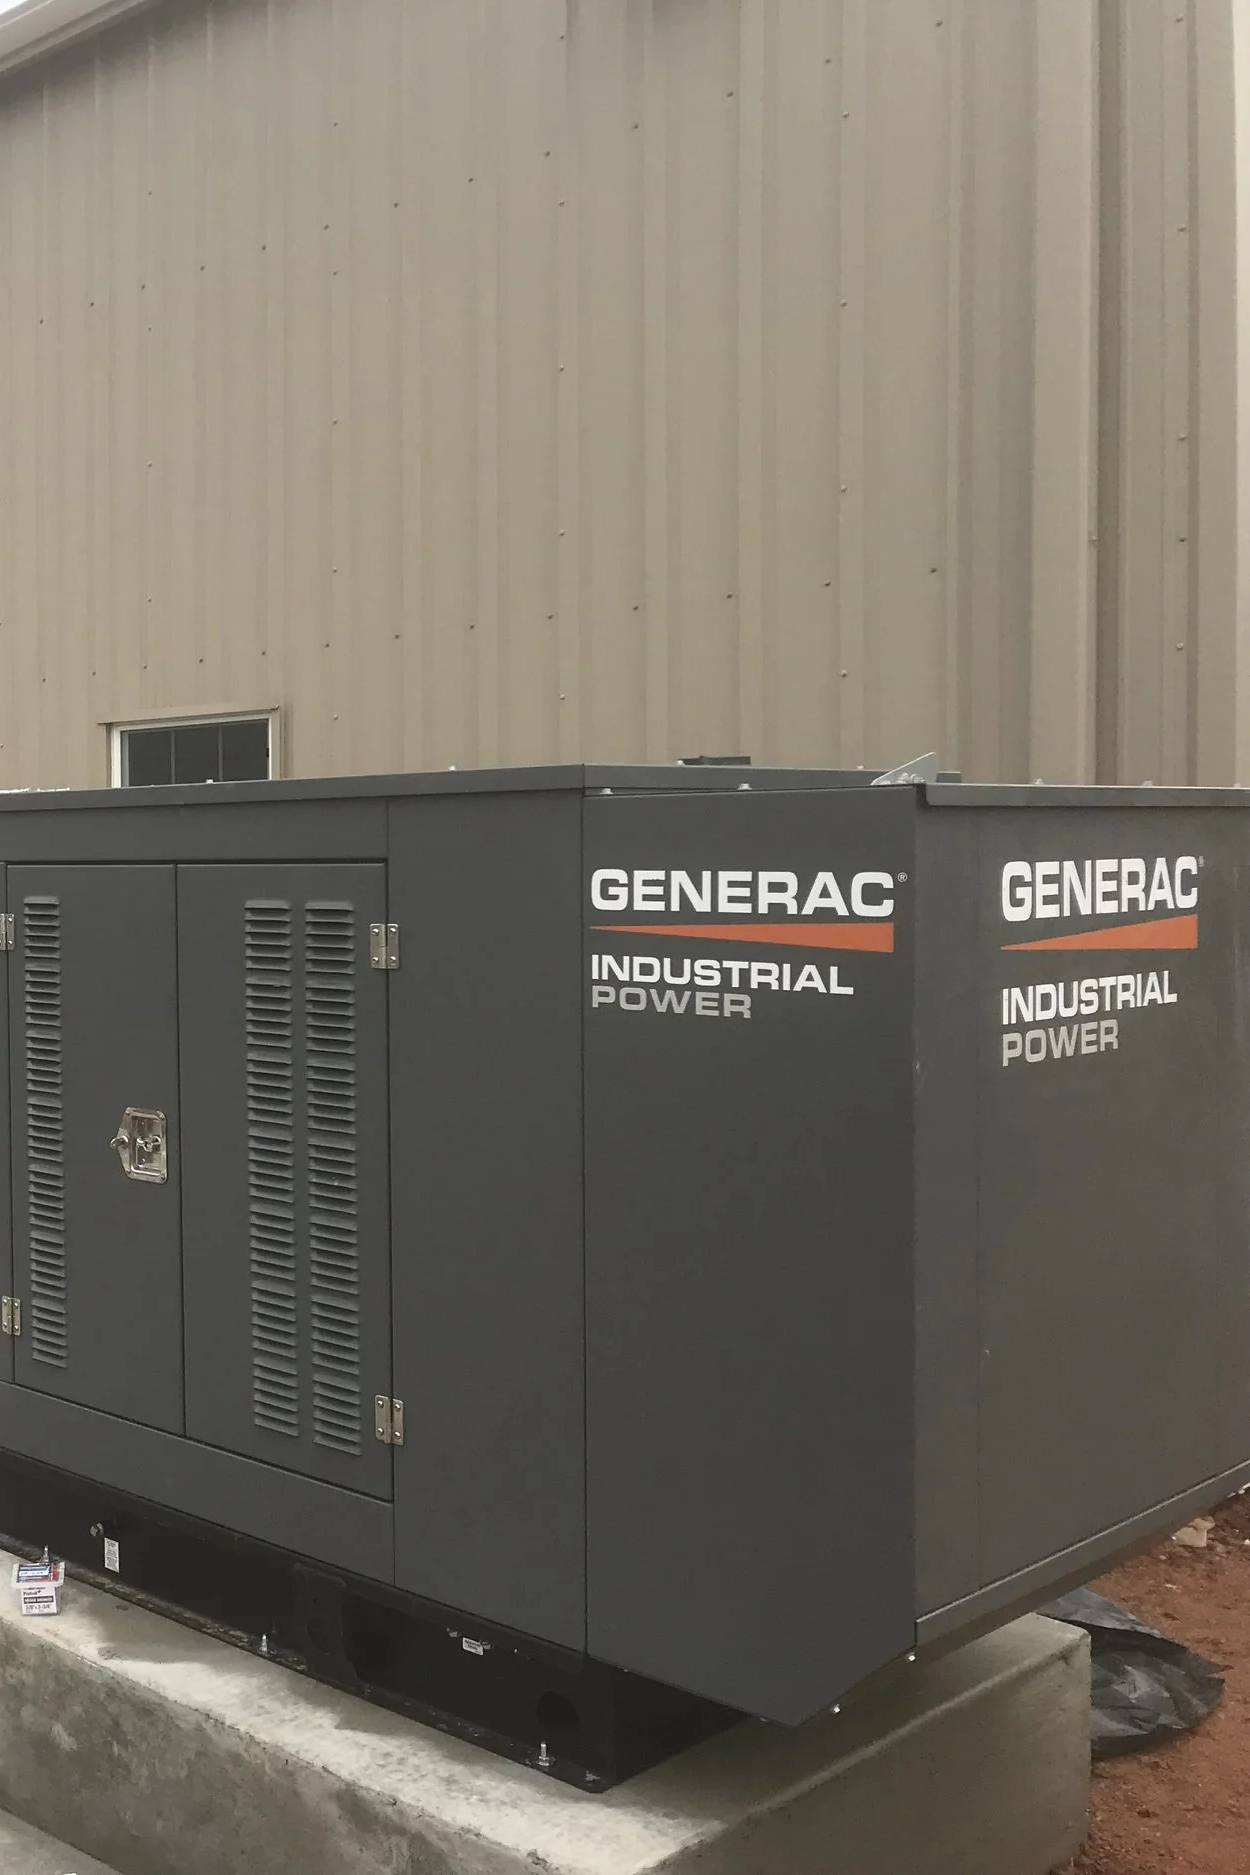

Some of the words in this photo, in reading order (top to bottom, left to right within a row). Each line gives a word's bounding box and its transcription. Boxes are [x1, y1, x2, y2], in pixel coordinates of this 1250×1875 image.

[591, 954, 855, 995] INDUSTRIAL
[591, 985, 752, 1019] POWER
[1002, 969, 1178, 1026] INDUSTRIAL
[1002, 1018, 1119, 1067] POWER
